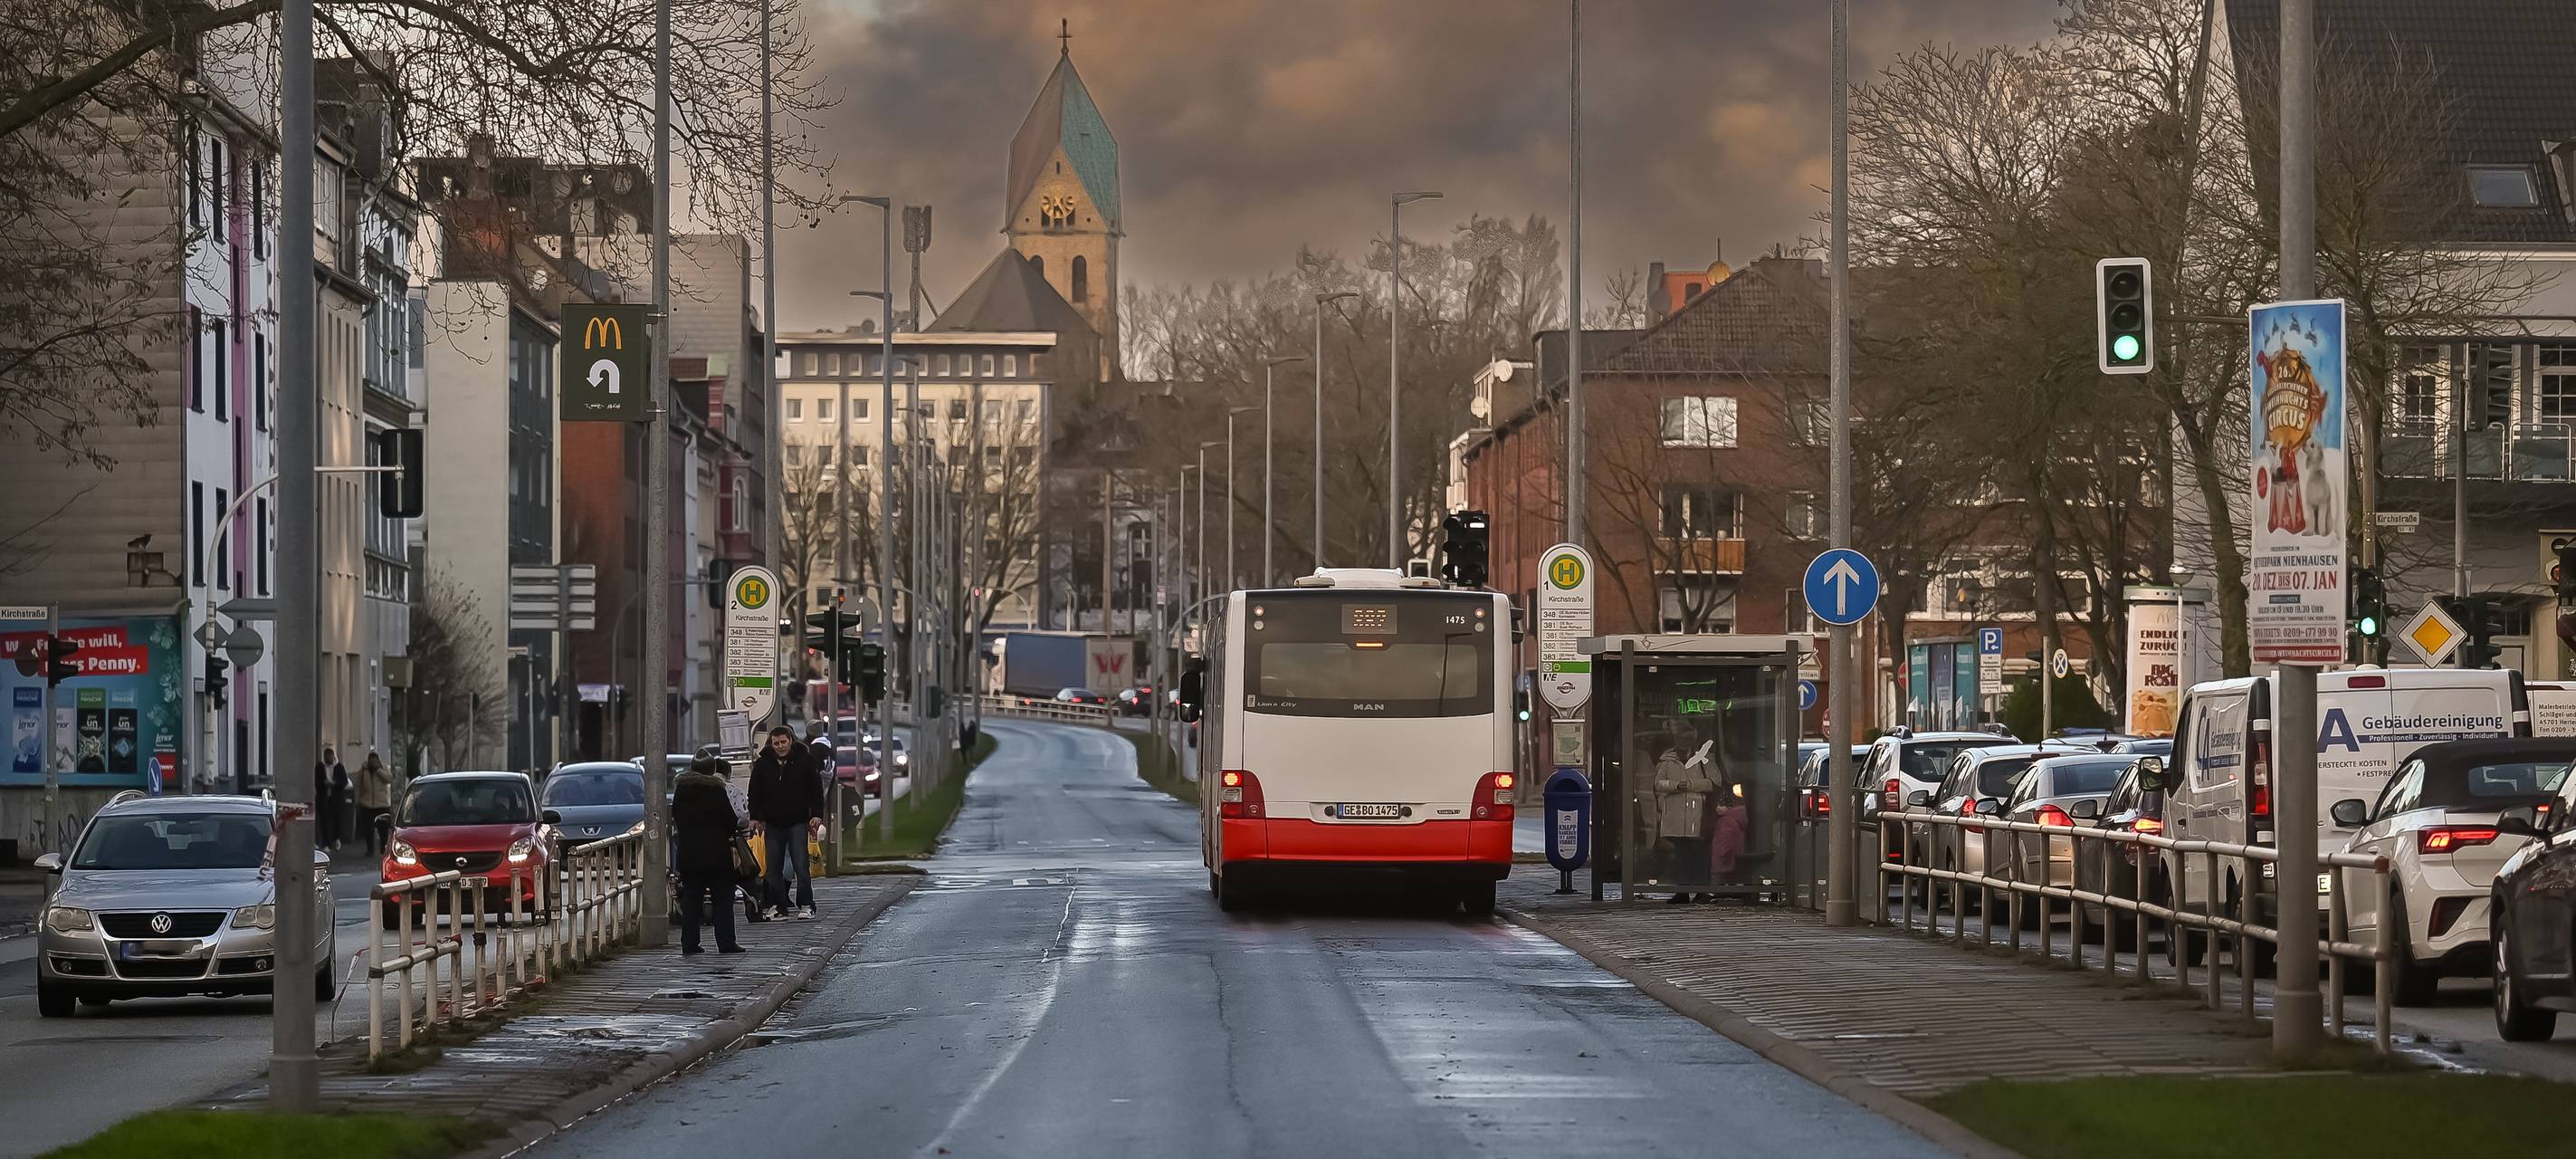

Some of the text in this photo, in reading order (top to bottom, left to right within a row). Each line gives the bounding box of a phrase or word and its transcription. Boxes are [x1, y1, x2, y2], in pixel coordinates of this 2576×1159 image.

[2268, 408, 2305, 430] CIRCUS
[2378, 514, 2417, 522] Kirchstraße
[2283, 555, 2338, 567] NIENHAUSEN
[1558, 562, 1575, 581] H
[1543, 580, 1549, 590] 1
[2263, 572, 2276, 590] DEZ
[2293, 571, 2309, 589] 07.
[2313, 570, 2337, 589] JAN
[745, 584, 760, 601] H
[730, 600, 738, 609] 2
[1549, 596, 1584, 604] Kirchstraße
[1, 608, 46, 618] Kirchstraße
[1445, 616, 1465, 624] 1475
[89, 634, 122, 648] will,
[1984, 631, 1997, 650] P
[2140, 639, 2187, 651] ZURÜC!
[89, 657, 141, 673] Penny.
[2362, 714, 2503, 730] Gebäudereinigung
[2317, 708, 2361, 753] A
[2419, 733, 2457, 742] Zuverlässig
[1344, 805, 1398, 815] GE BO 1475
